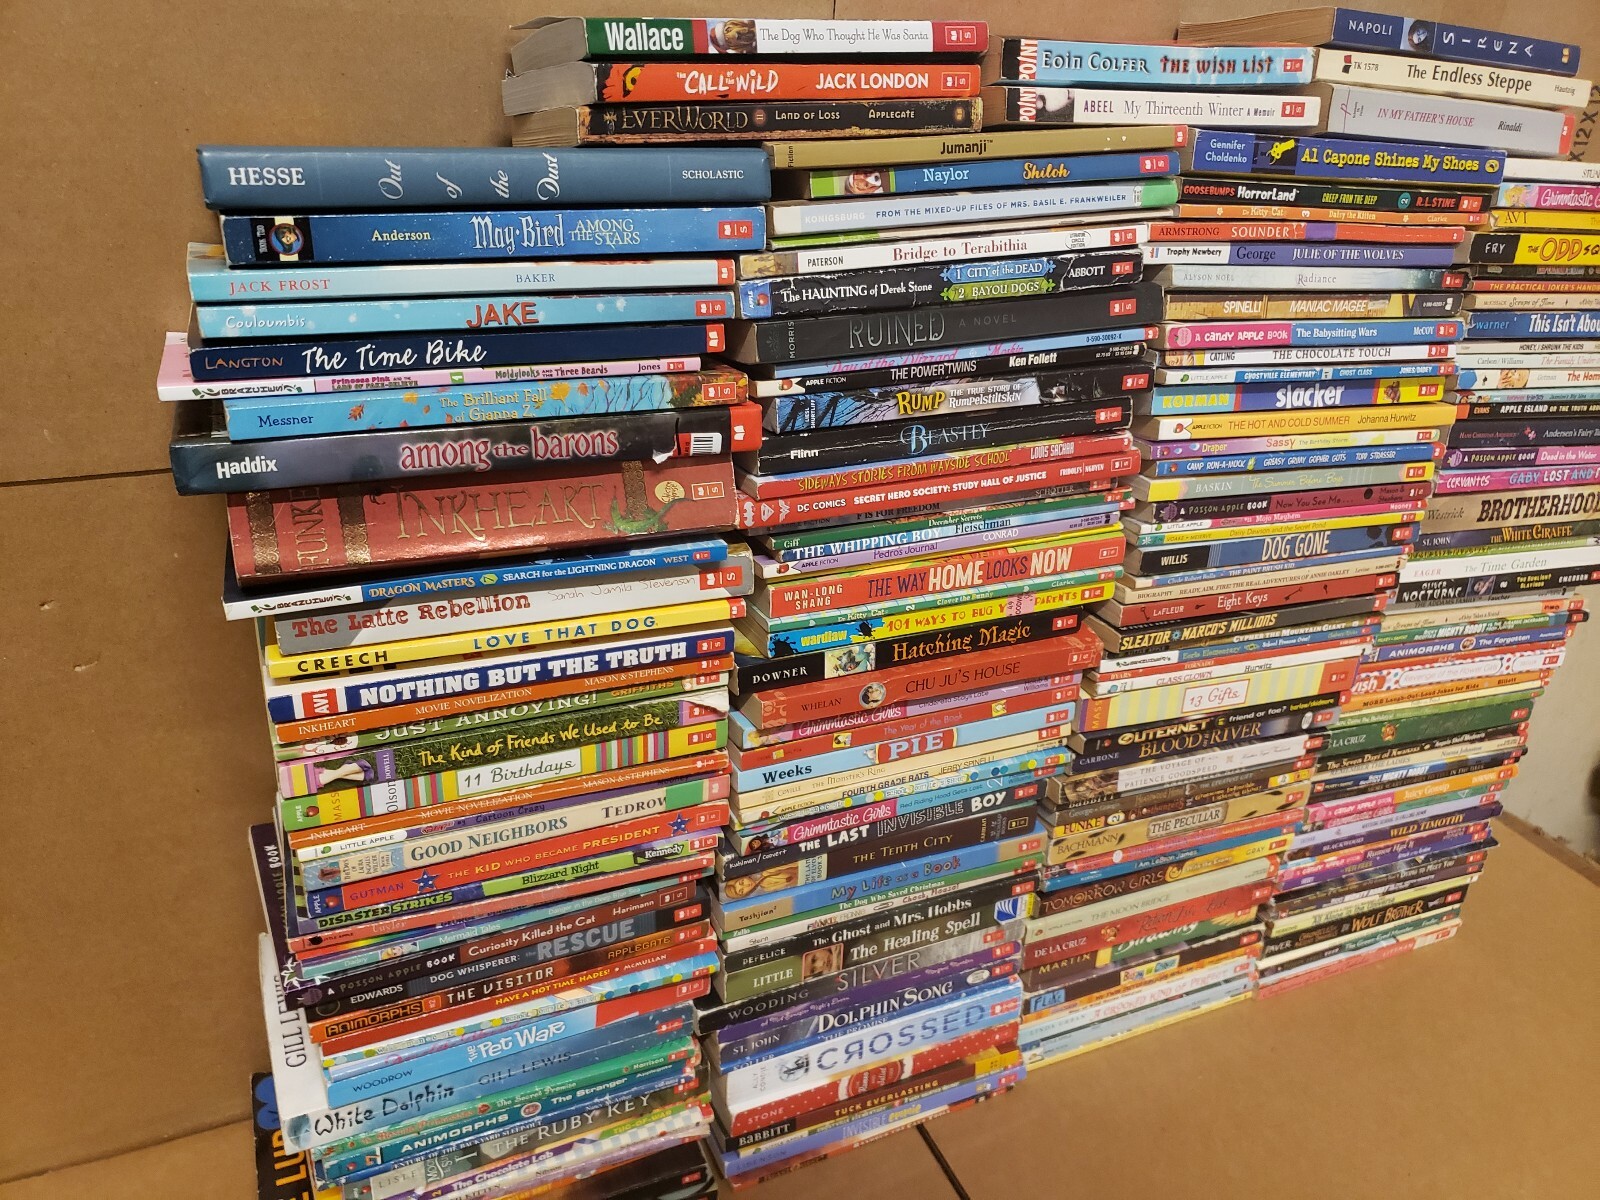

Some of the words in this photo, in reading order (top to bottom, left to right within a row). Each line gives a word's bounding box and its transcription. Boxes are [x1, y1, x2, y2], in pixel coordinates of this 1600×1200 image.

[604, 22, 684, 51] Wallace
[760, 28, 779, 41] The
[781, 28, 800, 44] Dog
[802, 28, 824, 41] Who
[826, 29, 865, 45] Thought
[867, 29, 880, 41] He
[883, 29, 900, 41] Was
[902, 29, 928, 41] Santa
[1349, 20, 1393, 36] NAPOLI
[1041, 50, 1082, 70] Eoin
[1088, 53, 1151, 74] COLFER
[815, 73, 857, 90] JACK
[860, 73, 929, 90] LONDON
[1407, 65, 1427, 79] The
[1432, 65, 1484, 85] Endless
[1487, 71, 1533, 93] Steppe
[1083, 100, 1115, 113] ABEEL
[1123, 101, 1142, 118] My
[1146, 101, 1204, 117] Thirteenth
[1208, 103, 1244, 118] Winter
[1404, 111, 1444, 125] FATHER'S
[1446, 114, 1475, 127] HOUSE
[1210, 139, 1246, 153] Gennifer
[1205, 151, 1248, 164] Choldenko
[1301, 148, 1319, 163] Al
[1322, 149, 1370, 169] Capone
[1374, 151, 1419, 169] Shines
[1423, 154, 1440, 173] My
[1442, 155, 1480, 172] Shoes
[228, 167, 306, 186] HESSE
[378, 158, 403, 200] Out
[536, 152, 561, 201] Dust
[682, 169, 744, 180] SCHOLASTIC
[923, 169, 970, 183] Naylor
[1023, 161, 1070, 179] Shiloh
[1070, 194, 1127, 205] FRANKWEILER
[1183, 186, 1235, 197] GOOSEBUMPS
[1505, 211, 1528, 224] AVI
[372, 229, 431, 242] Anderson
[1158, 226, 1220, 238] ARMSTRONG
[1231, 226, 1290, 239] SOUNDER
[893, 246, 938, 262] Bridge
[961, 240, 1028, 256] Terabithia
[1236, 246, 1276, 262] George
[1361, 249, 1405, 261] WOLVES
[1485, 241, 1506, 255] FRY
[807, 256, 844, 268] PATERSON
[1068, 265, 1106, 279] ABBOTT
[229, 280, 272, 296] JACK
[279, 278, 332, 292] FROST
[516, 273, 556, 284] BAKER
[802, 284, 868, 301] HAUNTING
[225, 314, 306, 329] Couloumbis
[466, 302, 540, 328] JAKE
[1529, 315, 1551, 334] This
[849, 310, 945, 350] RUINED
[205, 356, 284, 371] LANGTON
[302, 346, 347, 374] The
[356, 344, 418, 368] Time
[425, 339, 487, 365] Bike
[1272, 350, 1293, 360] THE
[1295, 347, 1354, 361] CHOCOLATE
[1358, 346, 1391, 359] TOUCH
[637, 361, 661, 373] Jones
[910, 363, 945, 379] POWER
[946, 360, 977, 376] TWINS
[896, 389, 946, 416] RUMP
[1276, 383, 1345, 409] slacker
[258, 414, 314, 428] Messner
[1358, 413, 1388, 424] Johanna
[1390, 412, 1417, 424] Hurwitz
[400, 438, 490, 472] among
[494, 443, 529, 456] the
[530, 426, 619, 460] barons
[216, 455, 278, 479] Haddix
[812, 499, 847, 511] COMICS
[854, 492, 886, 505] SECRET
[888, 489, 911, 501] HERO
[1015, 471, 1047, 484] JUSTICE
[1195, 481, 1233, 493] BASKIN
[391, 483, 605, 542] INKHEART
[1502, 526, 1532, 542] WHITE
[1262, 536, 1291, 562] DOG
[1293, 531, 1331, 559] GONE
[663, 554, 689, 564] WEST
[928, 560, 985, 593] HOME
[985, 556, 1028, 581] LOOKS
[1029, 546, 1073, 577] NOW
[1161, 553, 1189, 566] WILLIS
[795, 596, 831, 611] SHANG
[1217, 593, 1242, 610] Eight
[1245, 591, 1268, 607] Keys
[292, 617, 338, 639] The
[348, 607, 408, 631] Latte
[418, 593, 531, 621] Rebellion
[893, 635, 973, 662] Hatching
[978, 620, 1032, 648] Magic
[1121, 630, 1171, 651] SLEATOR
[1182, 618, 1227, 641] MARCO'S
[1229, 613, 1278, 633] MILLIONS
[297, 650, 389, 673] CREECH
[474, 631, 531, 651] LOVE
[544, 623, 598, 641] THAT
[611, 616, 656, 632] DOG
[359, 671, 480, 707] NOTHING
[486, 664, 541, 688] BUT
[605, 641, 687, 670] TRUTH
[752, 665, 809, 685] DOWNER
[800, 697, 843, 712] WHELAN
[905, 680, 936, 694] CHU
[972, 662, 1020, 682] HOUSE
[299, 718, 357, 735] INKHEART
[415, 701, 450, 715] MOVIE
[453, 687, 532, 709] NOVELIZATION
[506, 731, 555, 752] Friends
[584, 719, 617, 737] Used
[888, 732, 944, 761] PIE
[1139, 731, 1201, 759] BLOOD
[1210, 721, 1262, 747] RIVER
[1079, 751, 1120, 766] CARBONE
[491, 760, 576, 783] Birthdays
[762, 764, 813, 784] Weeks
[827, 824, 870, 847] LAST
[971, 791, 1007, 813] BOY
[1174, 809, 1220, 830] PECULIAR
[1389, 823, 1418, 838] WILD
[1419, 814, 1465, 833] TIMOTHY
[468, 816, 568, 851] NEIGHBORS
[582, 826, 660, 850] PRESIDENT
[644, 843, 684, 860] Kennedy
[1057, 835, 1119, 855] BACHMANN
[522, 867, 569, 885] Blizzard
[570, 860, 600, 877] Night
[350, 883, 404, 901] GUTMAN
[832, 924, 871, 946] Ghost
[893, 907, 925, 929] Mrs.
[928, 897, 973, 918] Hobbs
[1384, 901, 1424, 922] BROTHER
[468, 938, 521, 957] Curiosity
[612, 899, 655, 917] Harimann
[883, 926, 940, 955] Healing
[945, 911, 981, 935] Spell
[537, 918, 636, 961] RESCUE
[607, 936, 671, 960] APPLEGATE
[483, 966, 555, 995] VISITOR
[753, 969, 794, 988] LITTLE
[350, 983, 404, 1005] EDWARDS
[352, 1069, 413, 1093] WOODROW
[866, 1080, 940, 1109] EVERLASTING
[539, 1111, 596, 1141] RUBY
